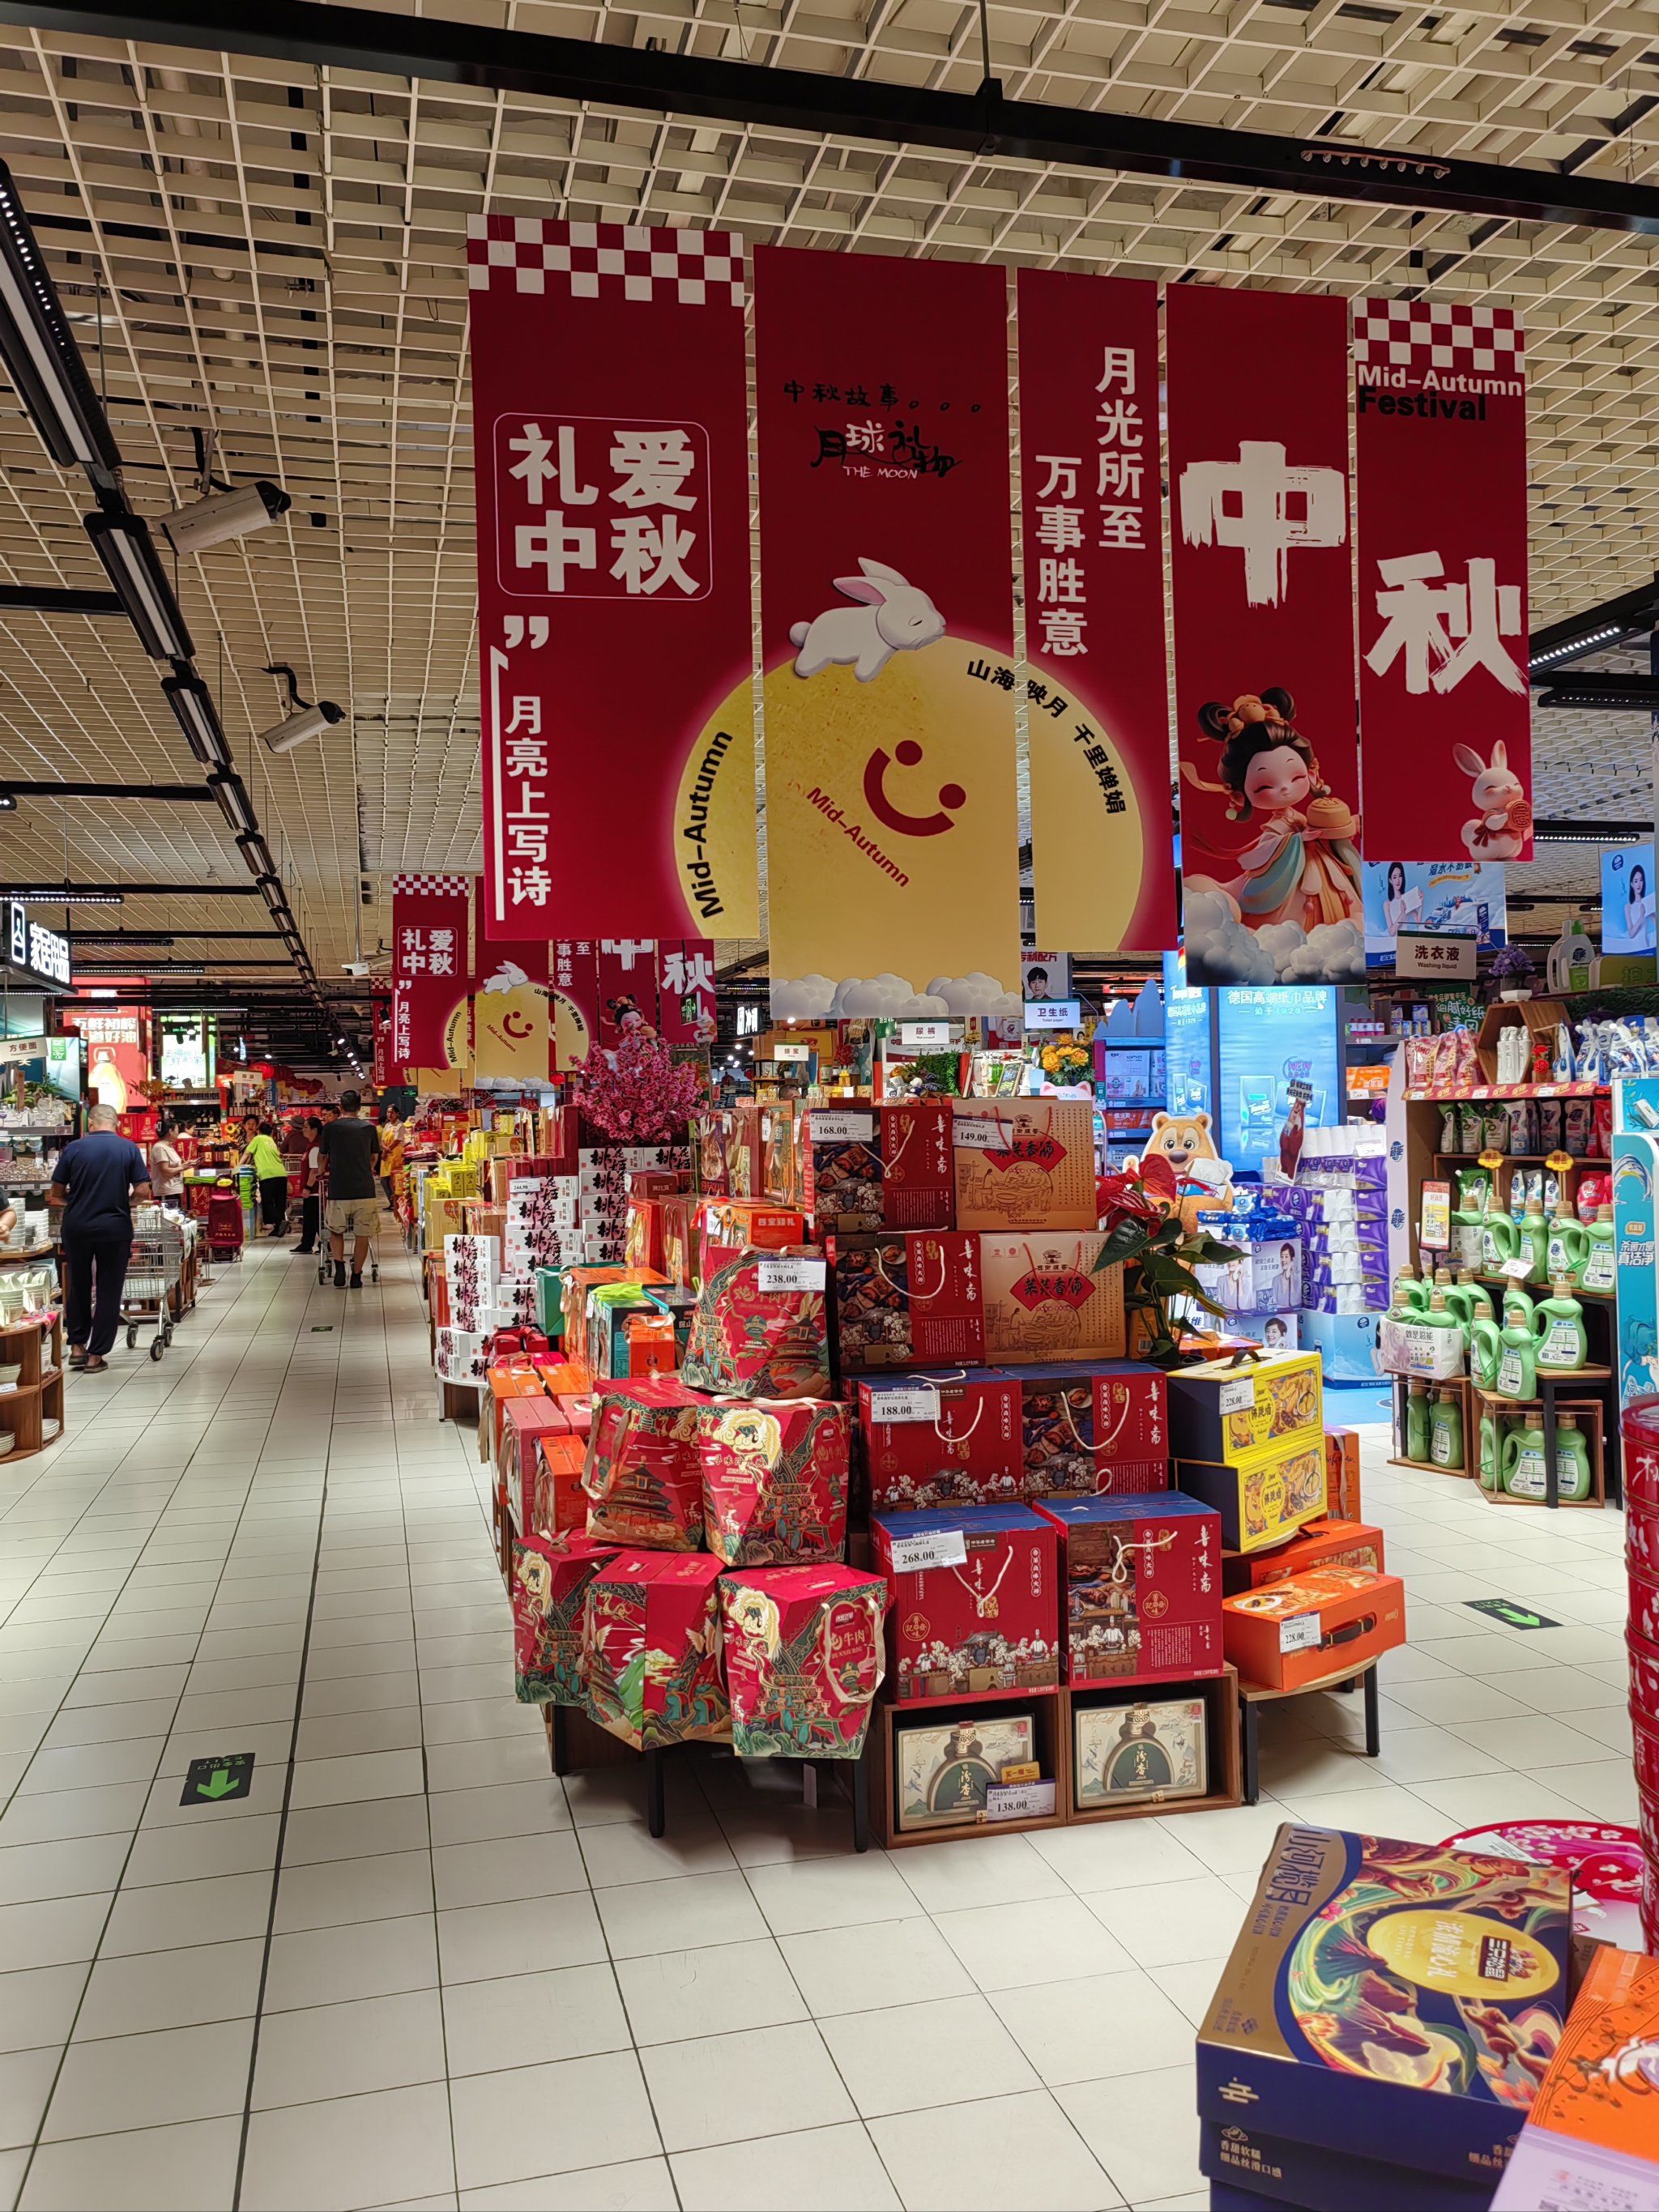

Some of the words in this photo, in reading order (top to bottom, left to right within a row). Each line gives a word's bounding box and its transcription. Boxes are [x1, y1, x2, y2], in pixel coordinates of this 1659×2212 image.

[1358, 386, 1486, 421] Festival
[1095, 347, 1145, 550] 月光所至
[508, 423, 697, 511] 礼爱
[842, 466, 872, 479] THE
[876, 467, 918, 479] MOON
[1179, 440, 1346, 609] 中
[514, 510, 700, 595] 中秋
[1035, 455, 1088, 656] 万事胜意
[1363, 551, 1528, 697] 秋
[967, 659, 1068, 718] 山海映月
[1073, 723, 1127, 814] 千里婵娟
[505, 696, 552, 906] 月亮上写诗
[401, 929, 454, 953] 礼爱
[576, 942, 591, 955] 至
[1415, 945, 1459, 961] 洗衣液
[402, 952, 454, 975] 中秋
[557, 940, 573, 987] 事胜意
[662, 952, 715, 995] 秋
[1228, 990, 1328, 1004] 德国高端纸巾品牌
[1038, 1008, 1068, 1016] 卫生纸
[399, 1002, 411, 1059] 月亮上写诗
[10, 1042, 36, 1052] 方便面
[819, 1126, 847, 1135] 168.00
[961, 1132, 987, 1142] 149.00
[519, 1199, 557, 1225] 桃花姬
[525, 1230, 562, 1255] 桃花姬
[1618, 1251, 1654, 1265] 真洁净
[767, 1274, 797, 1285] 238.00
[881, 1406, 911, 1416] 188.00
[1226, 1396, 1243, 1407] 228.00
[902, 1550, 935, 1564] 268.00
[1286, 1631, 1305, 1643] 228.00
[997, 1801, 1027, 1812] 138.00
[1267, 1828, 1332, 1906] 山河揽月
[1427, 1920, 1464, 1978] 浓情流心礼
[1485, 1938, 1507, 1979] 三只松鼠
[1220, 2140, 1261, 2160] 香甜软糯
[1219, 2151, 1282, 2178] 细品丝滑口感
